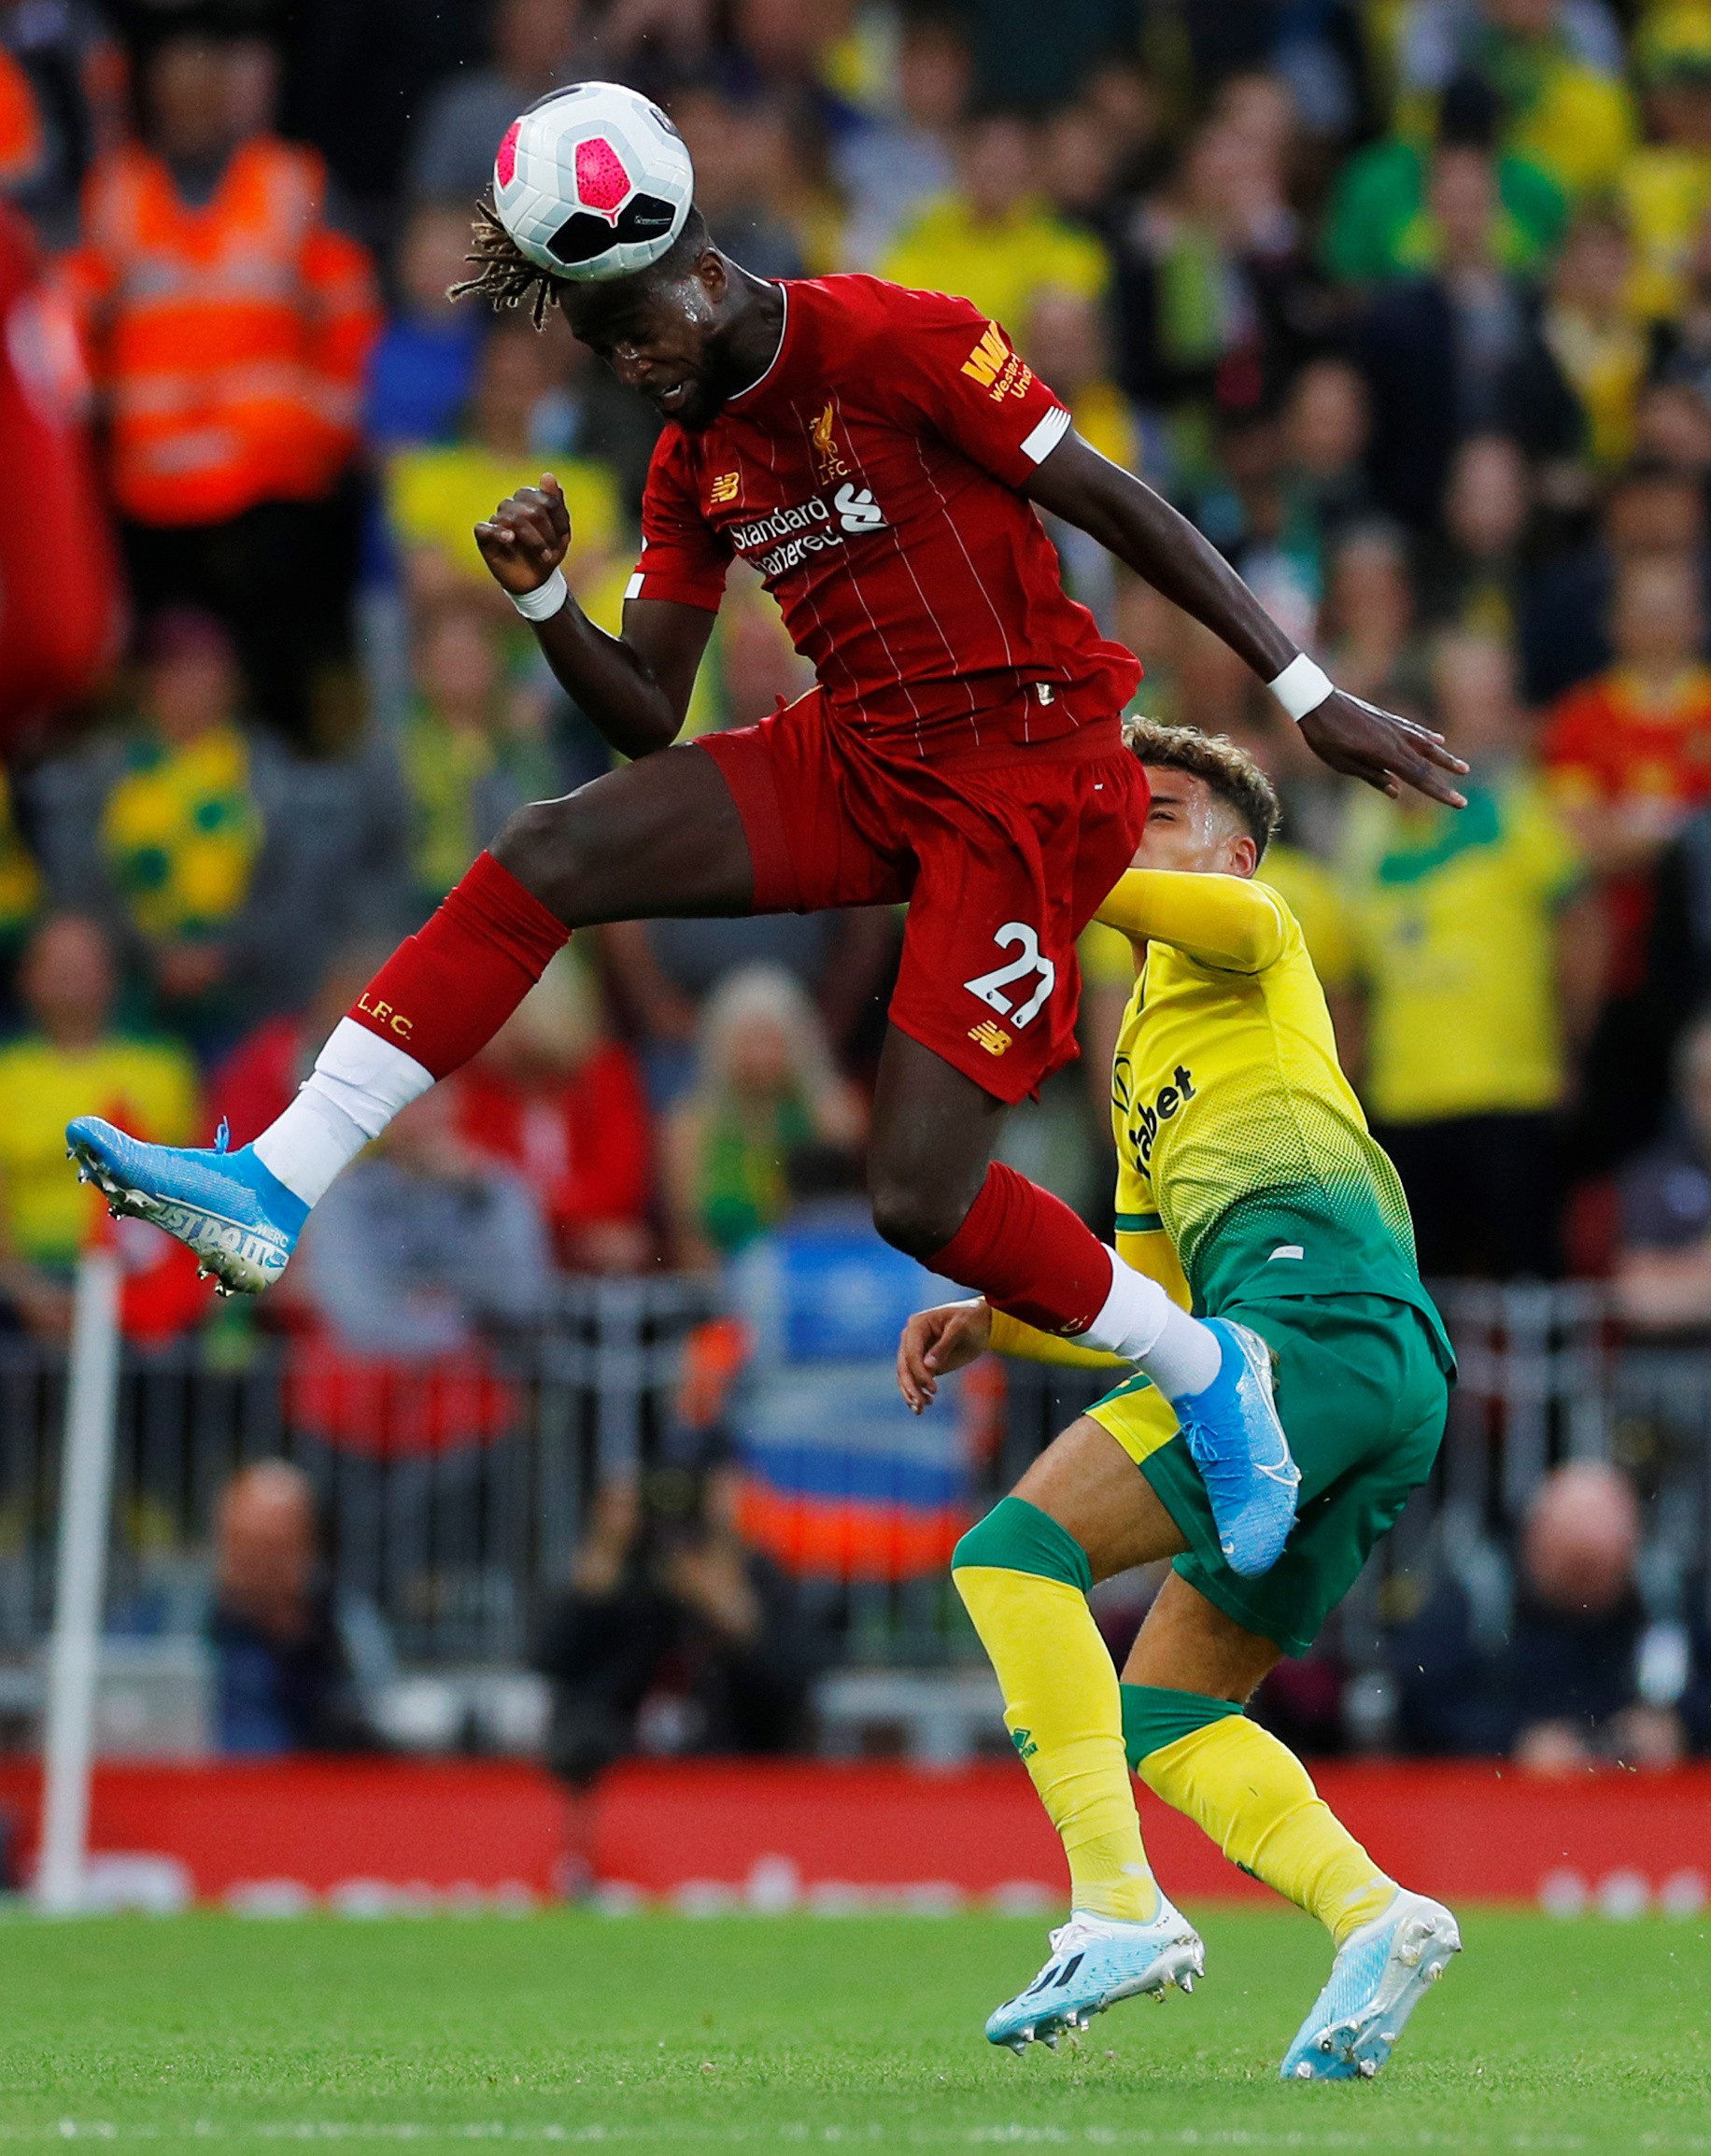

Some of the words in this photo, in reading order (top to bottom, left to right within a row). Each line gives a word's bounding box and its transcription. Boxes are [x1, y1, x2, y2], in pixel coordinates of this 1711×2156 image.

[1011, 363, 1033, 399] Unio
[728, 495, 830, 550] Standard
[748, 525, 843, 575] hartered
[154, 1200, 204, 1234] UST
